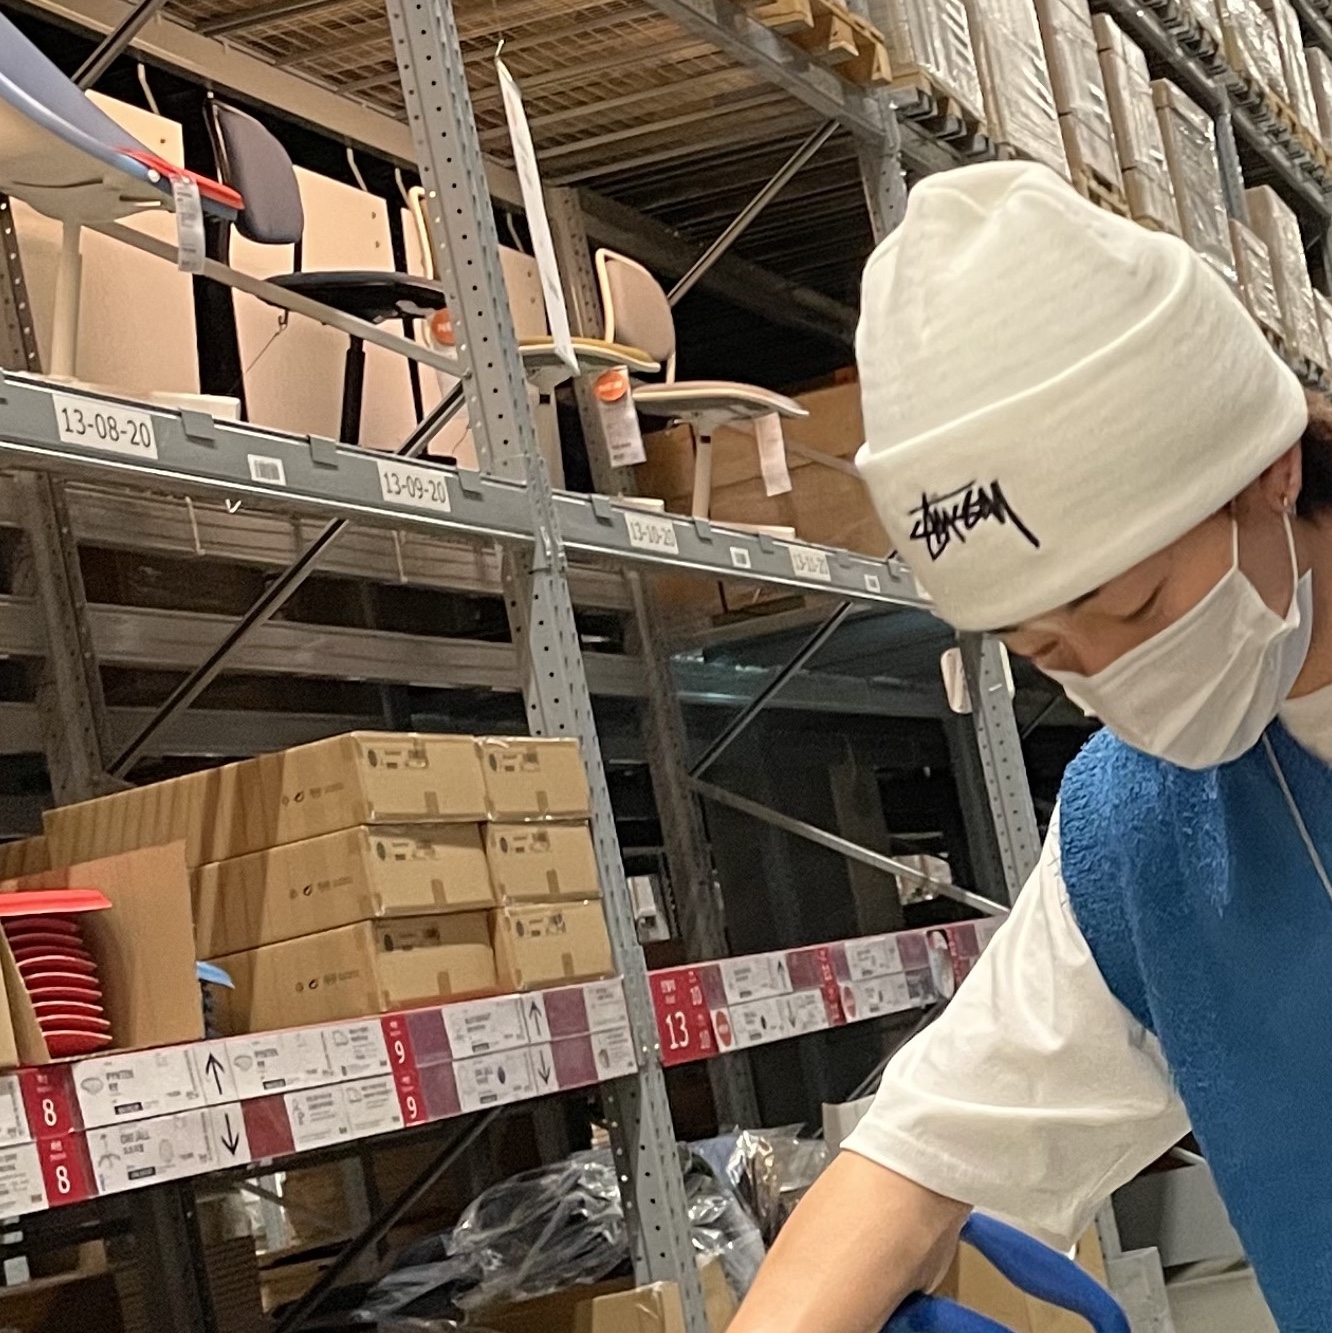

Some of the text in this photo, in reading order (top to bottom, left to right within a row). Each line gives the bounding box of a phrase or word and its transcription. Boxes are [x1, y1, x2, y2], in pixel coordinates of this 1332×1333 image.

[62, 407, 151, 448] 13-08-20
[384, 471, 446, 504] 13-09-20
[630, 521, 676, 548] 13-10-20
[665, 1011, 689, 1050] 13
[394, 1040, 406, 1064] 9
[42, 1098, 57, 1126] 8
[406, 1096, 418, 1119] 9
[55, 1165, 71, 1194] 8
